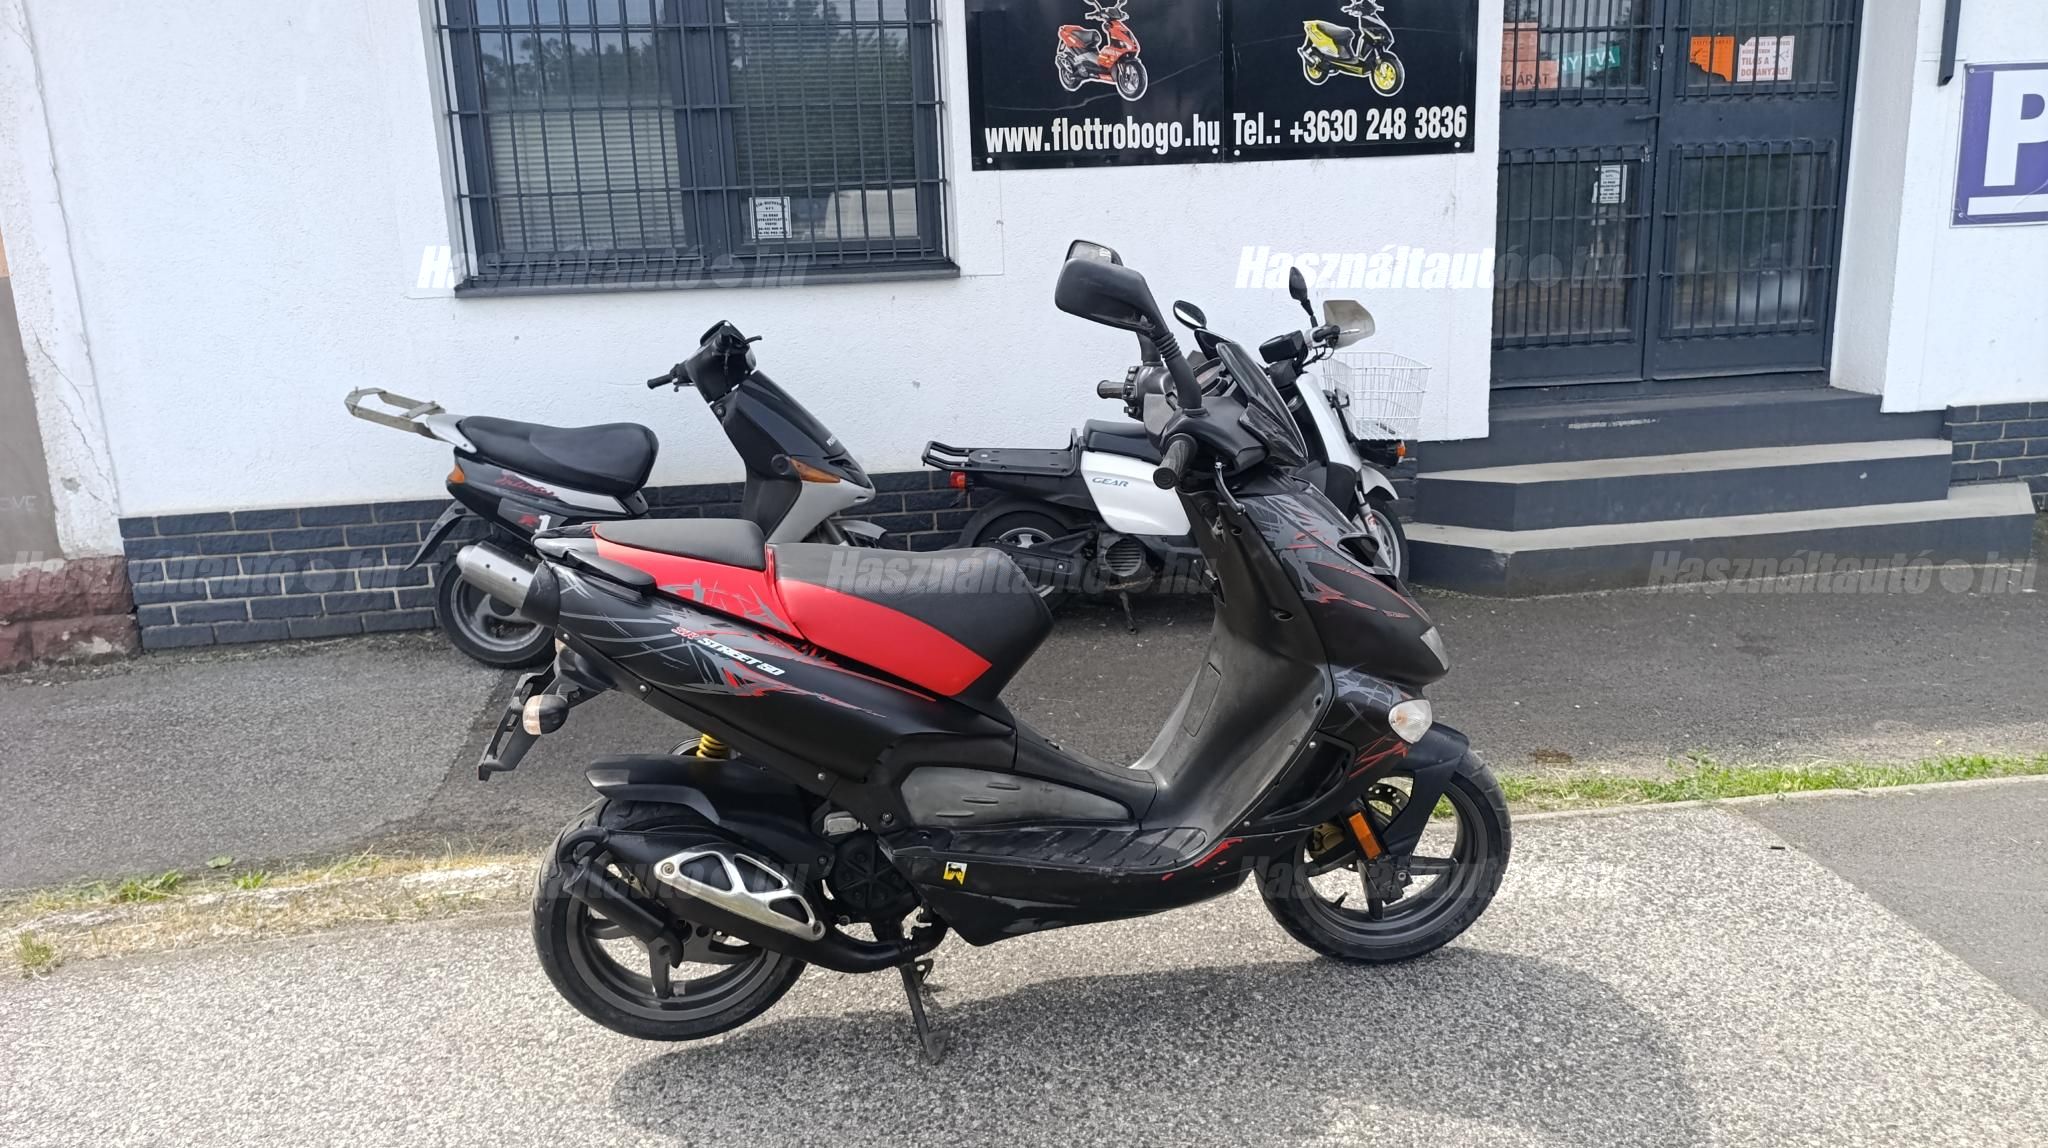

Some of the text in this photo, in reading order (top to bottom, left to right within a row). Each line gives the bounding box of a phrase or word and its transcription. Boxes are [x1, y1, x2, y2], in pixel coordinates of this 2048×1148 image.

[1742, 57, 1762, 65] TILS
[985, 113, 1220, 155] www.flottrobogo.hu
[1233, 104, 1467, 146] Tel.: +3630 248 3836
[1983, 68, 2048, 187] P
[1092, 477, 1129, 488] GEAR
[697, 637, 763, 665] STREET
[756, 662, 786, 676] 50
